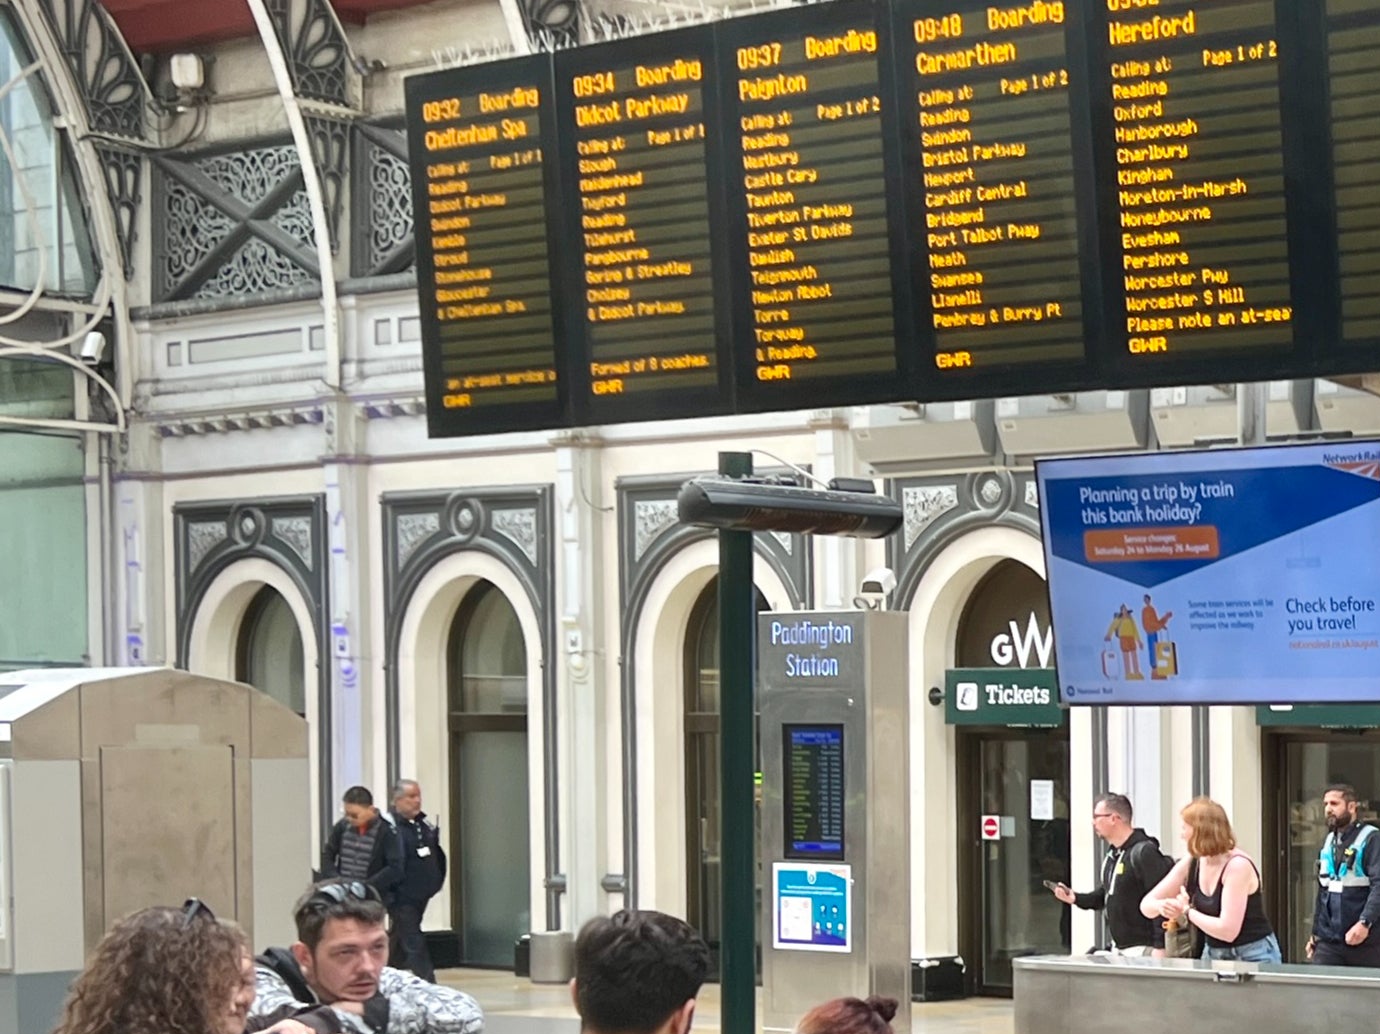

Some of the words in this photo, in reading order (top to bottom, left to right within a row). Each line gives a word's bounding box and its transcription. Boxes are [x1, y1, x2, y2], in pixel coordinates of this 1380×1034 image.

[915, 14, 964, 43] 09:48
[988, 0, 1065, 30] Boarding
[1109, 12, 1196, 46] Hereford
[738, 43, 782, 69] 09:37
[805, 31, 878, 60] Boarding
[917, 43, 1017, 75] Carmarthen
[574, 74, 616, 97] 09:34
[636, 60, 703, 87] Boarding
[740, 75, 808, 100] Paignton
[424, 100, 460, 121] 09:32
[480, 88, 539, 112] Boarding
[577, 102, 622, 126] Didcot
[625, 94, 689, 118] Parkway
[1115, 101, 1164, 121] Oxford
[426, 126, 500, 150] Cheltenham
[502, 120, 528, 139] Spa
[1120, 180, 1247, 206] Moreton-in-Marsh
[1122, 230, 1180, 249] Evesham
[1129, 336, 1168, 353] GWR
[936, 351, 973, 368] GWR
[757, 364, 792, 380] GWR
[593, 378, 624, 394] GWR
[1080, 486, 1138, 504] Planning
[1141, 489, 1151, 500] a
[1152, 484, 1177, 503] trip
[1179, 482, 1197, 502] by
[1199, 481, 1234, 499] train
[1081, 507, 1107, 525] this
[1109, 506, 1143, 523] bank
[1145, 502, 1202, 525] holiday?
[1286, 598, 1326, 614] Check
[1330, 596, 1375, 613] before
[771, 622, 852, 649] Paddington
[1287, 618, 1313, 635] you
[1317, 614, 1357, 630] travel
[991, 611, 1053, 669] GW
[786, 653, 839, 677] Station
[985, 684, 1050, 705] Tickets
